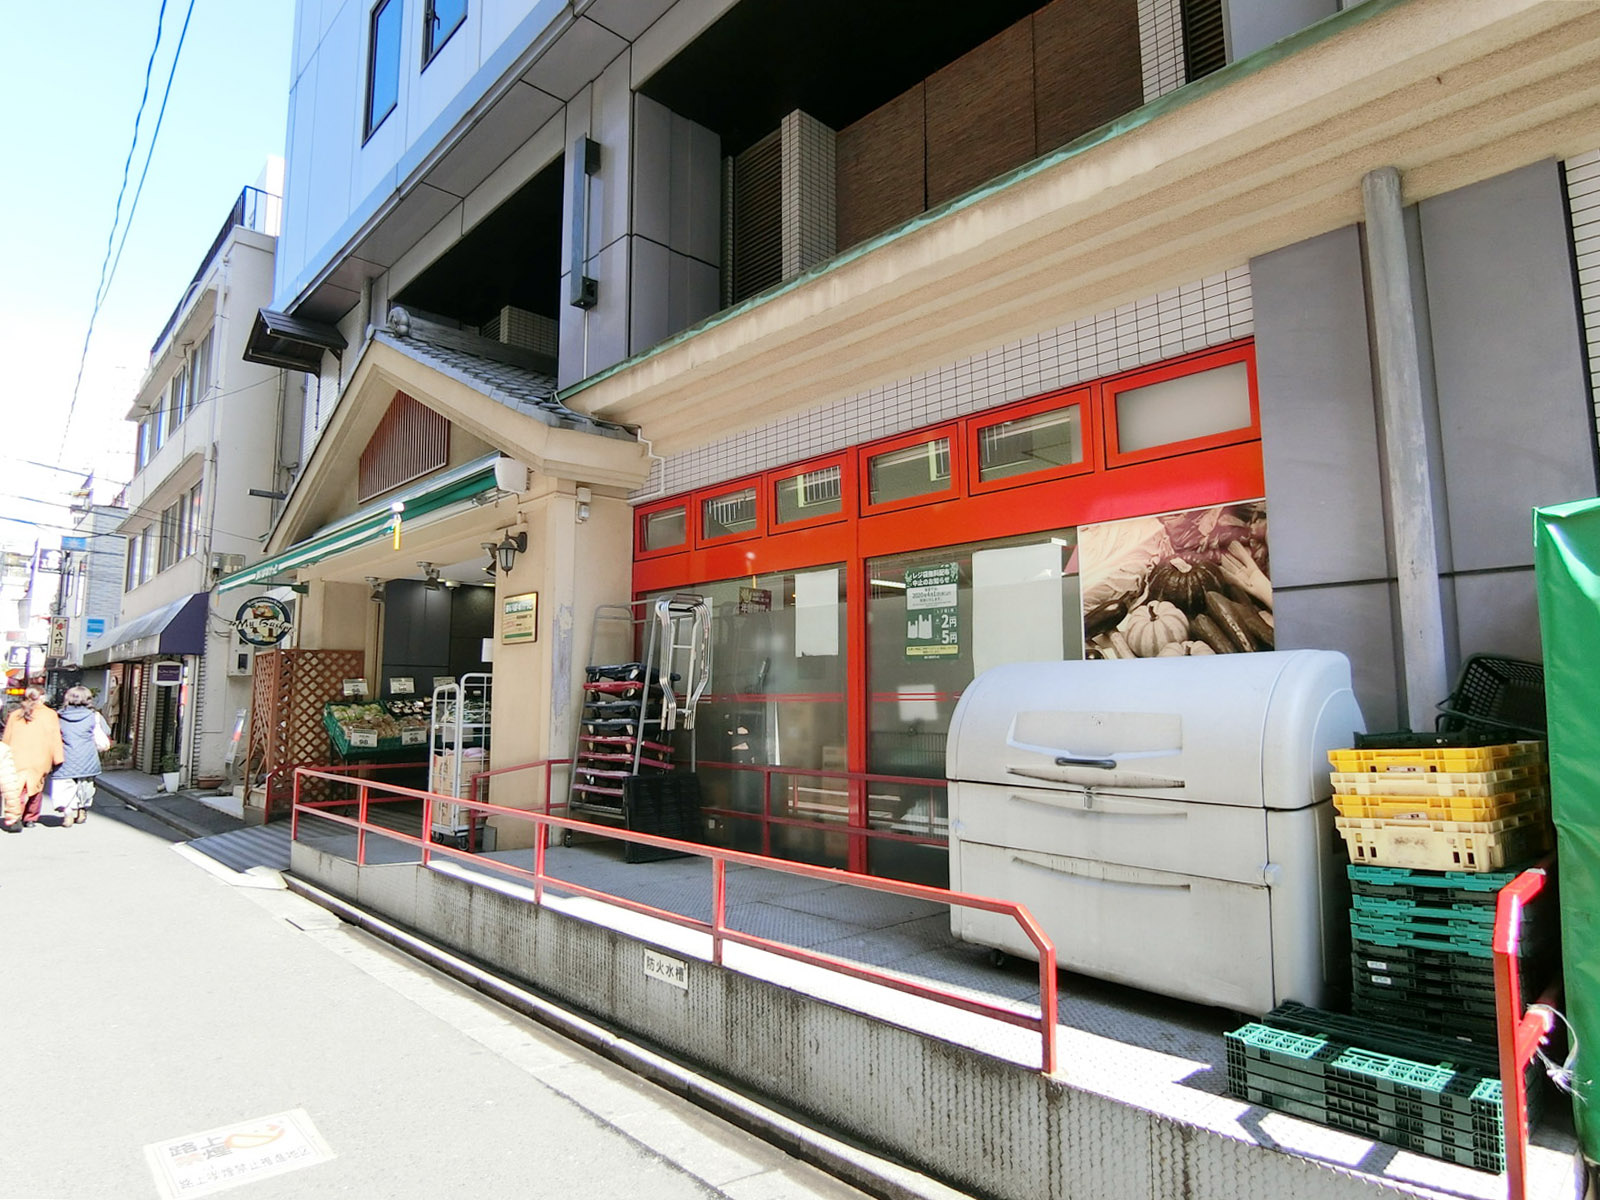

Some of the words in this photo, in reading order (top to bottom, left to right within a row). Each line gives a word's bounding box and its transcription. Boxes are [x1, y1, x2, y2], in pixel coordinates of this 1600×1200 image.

[941, 614, 957, 628] 2円
[941, 629, 958, 644] 5円
[647, 956, 684, 982] 防火水槽
